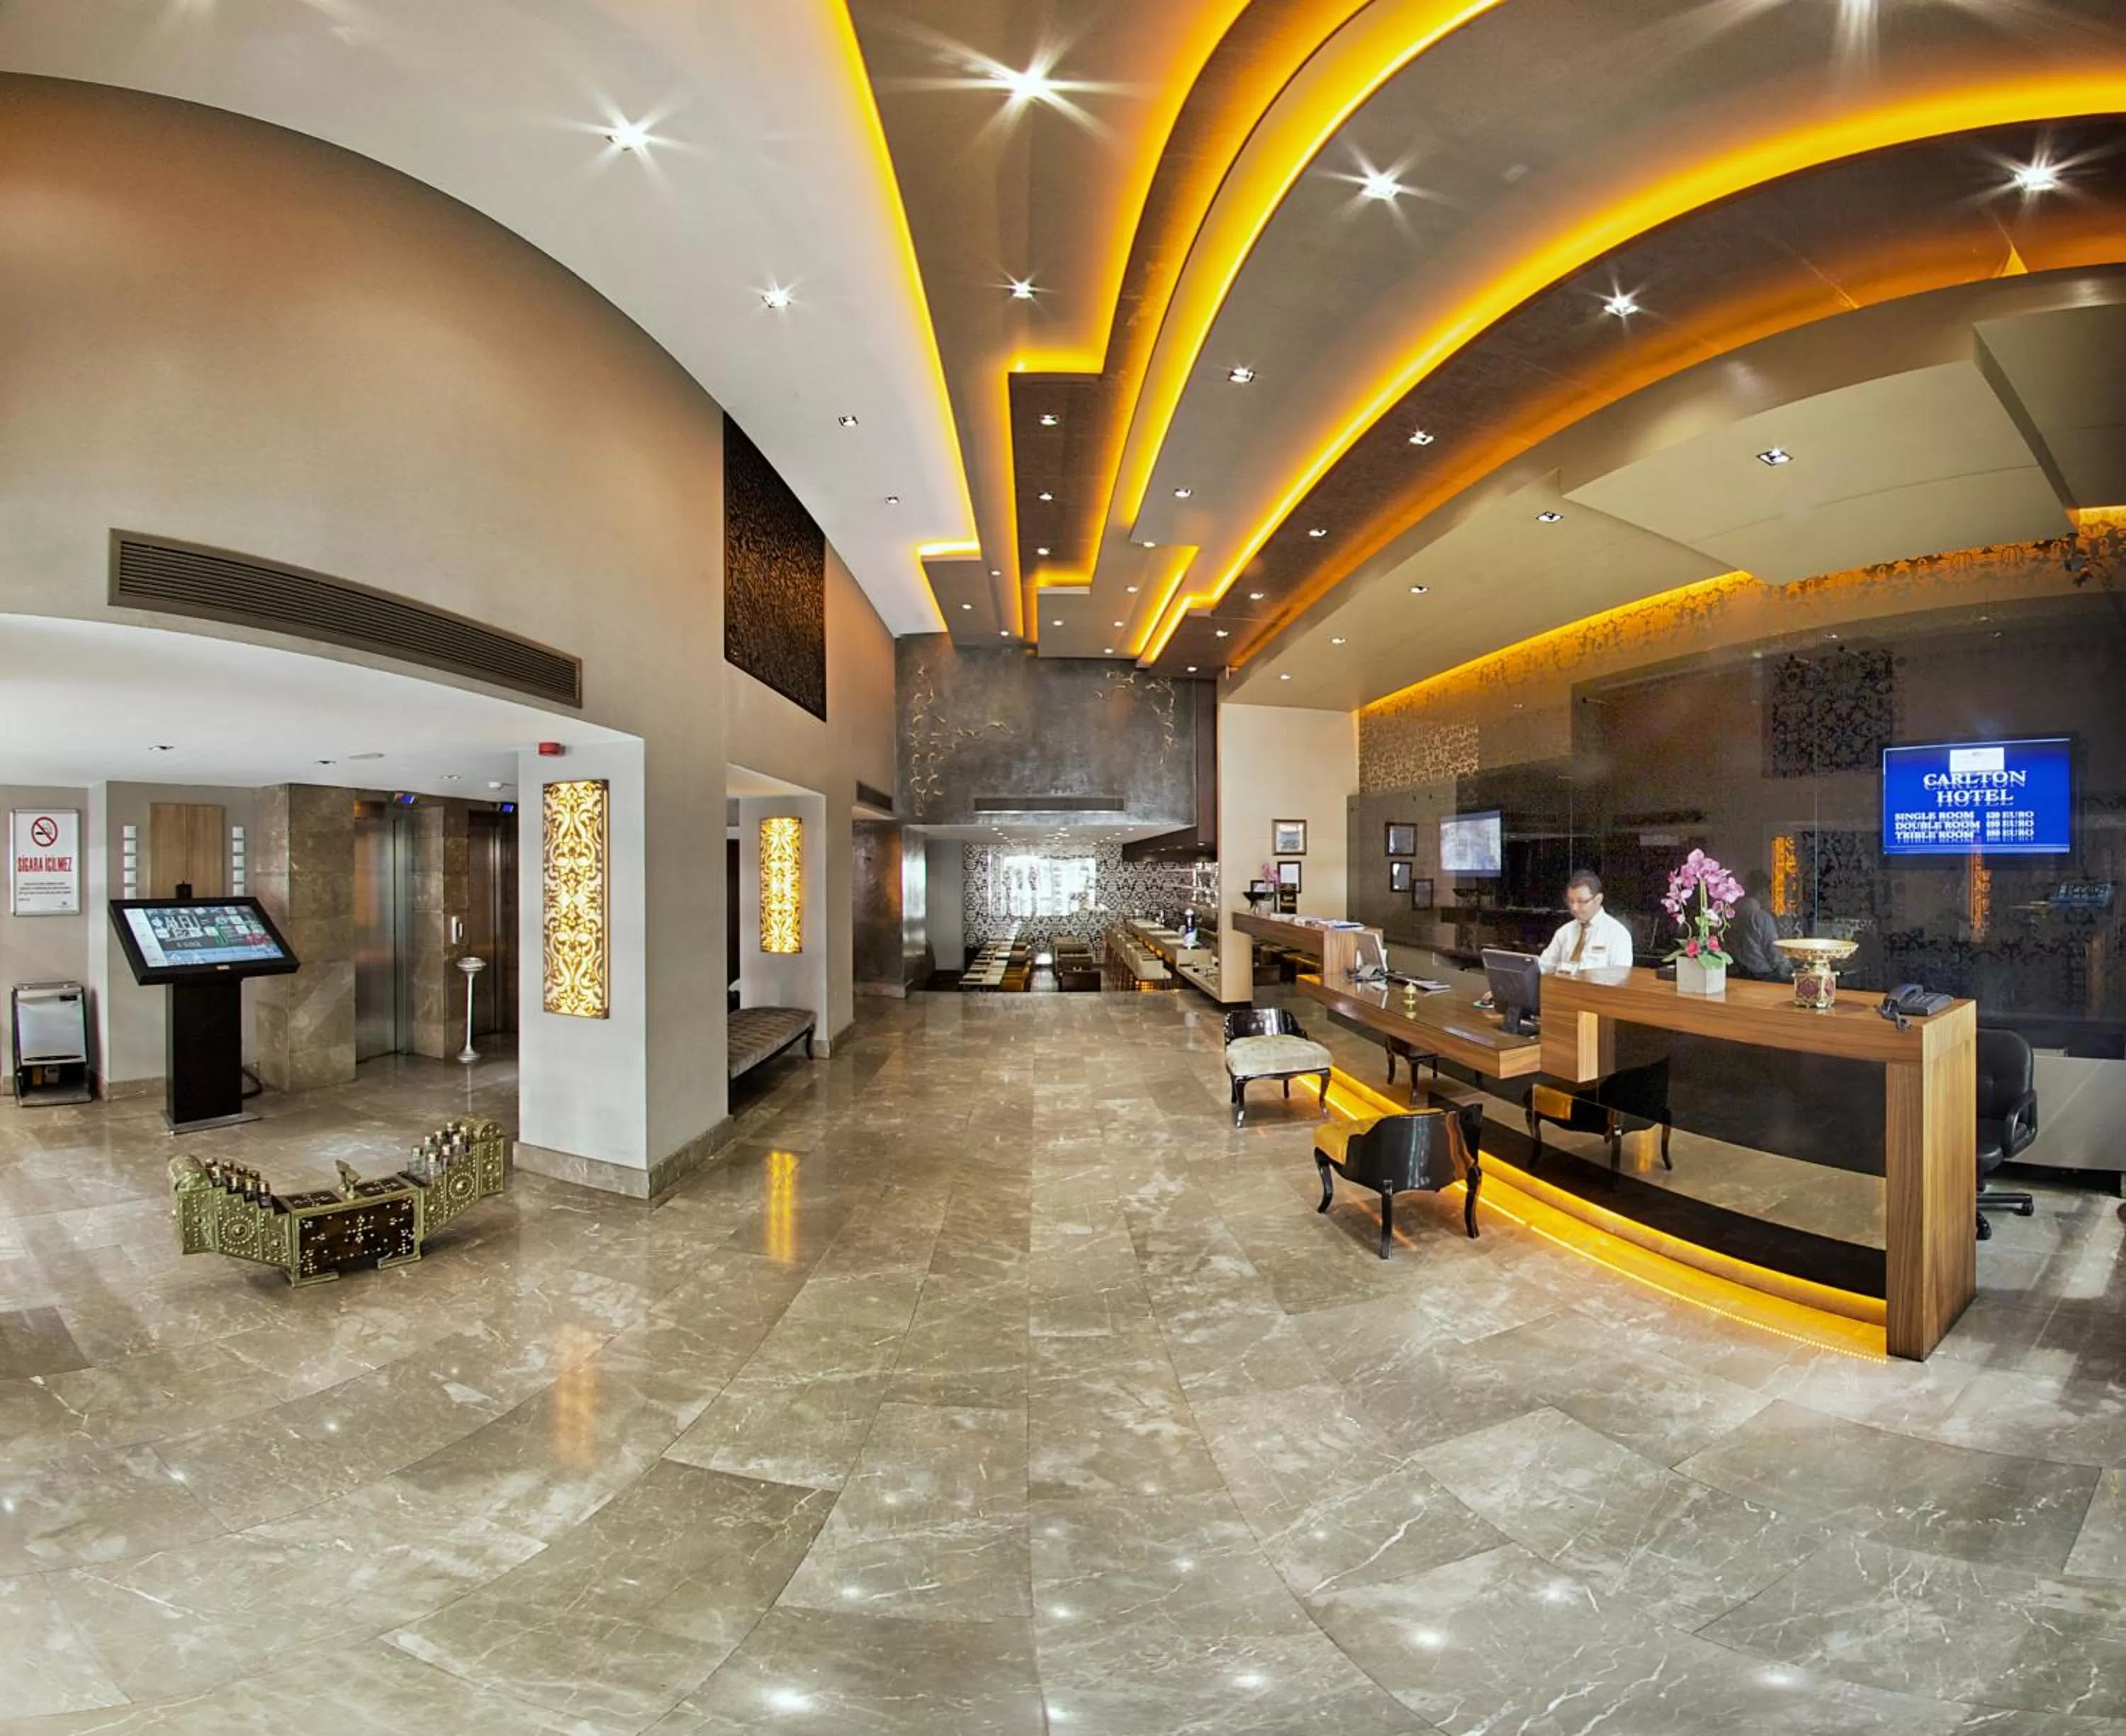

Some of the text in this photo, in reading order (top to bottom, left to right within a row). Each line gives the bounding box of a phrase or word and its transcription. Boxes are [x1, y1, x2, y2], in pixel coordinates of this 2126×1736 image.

[1923, 770, 2027, 788] CARLTON
[1937, 789, 2014, 806] HOTEL
[1938, 811, 1974, 821] ROOM
[1944, 821, 1981, 830] ROOM
[1938, 830, 1974, 840] ROOM
